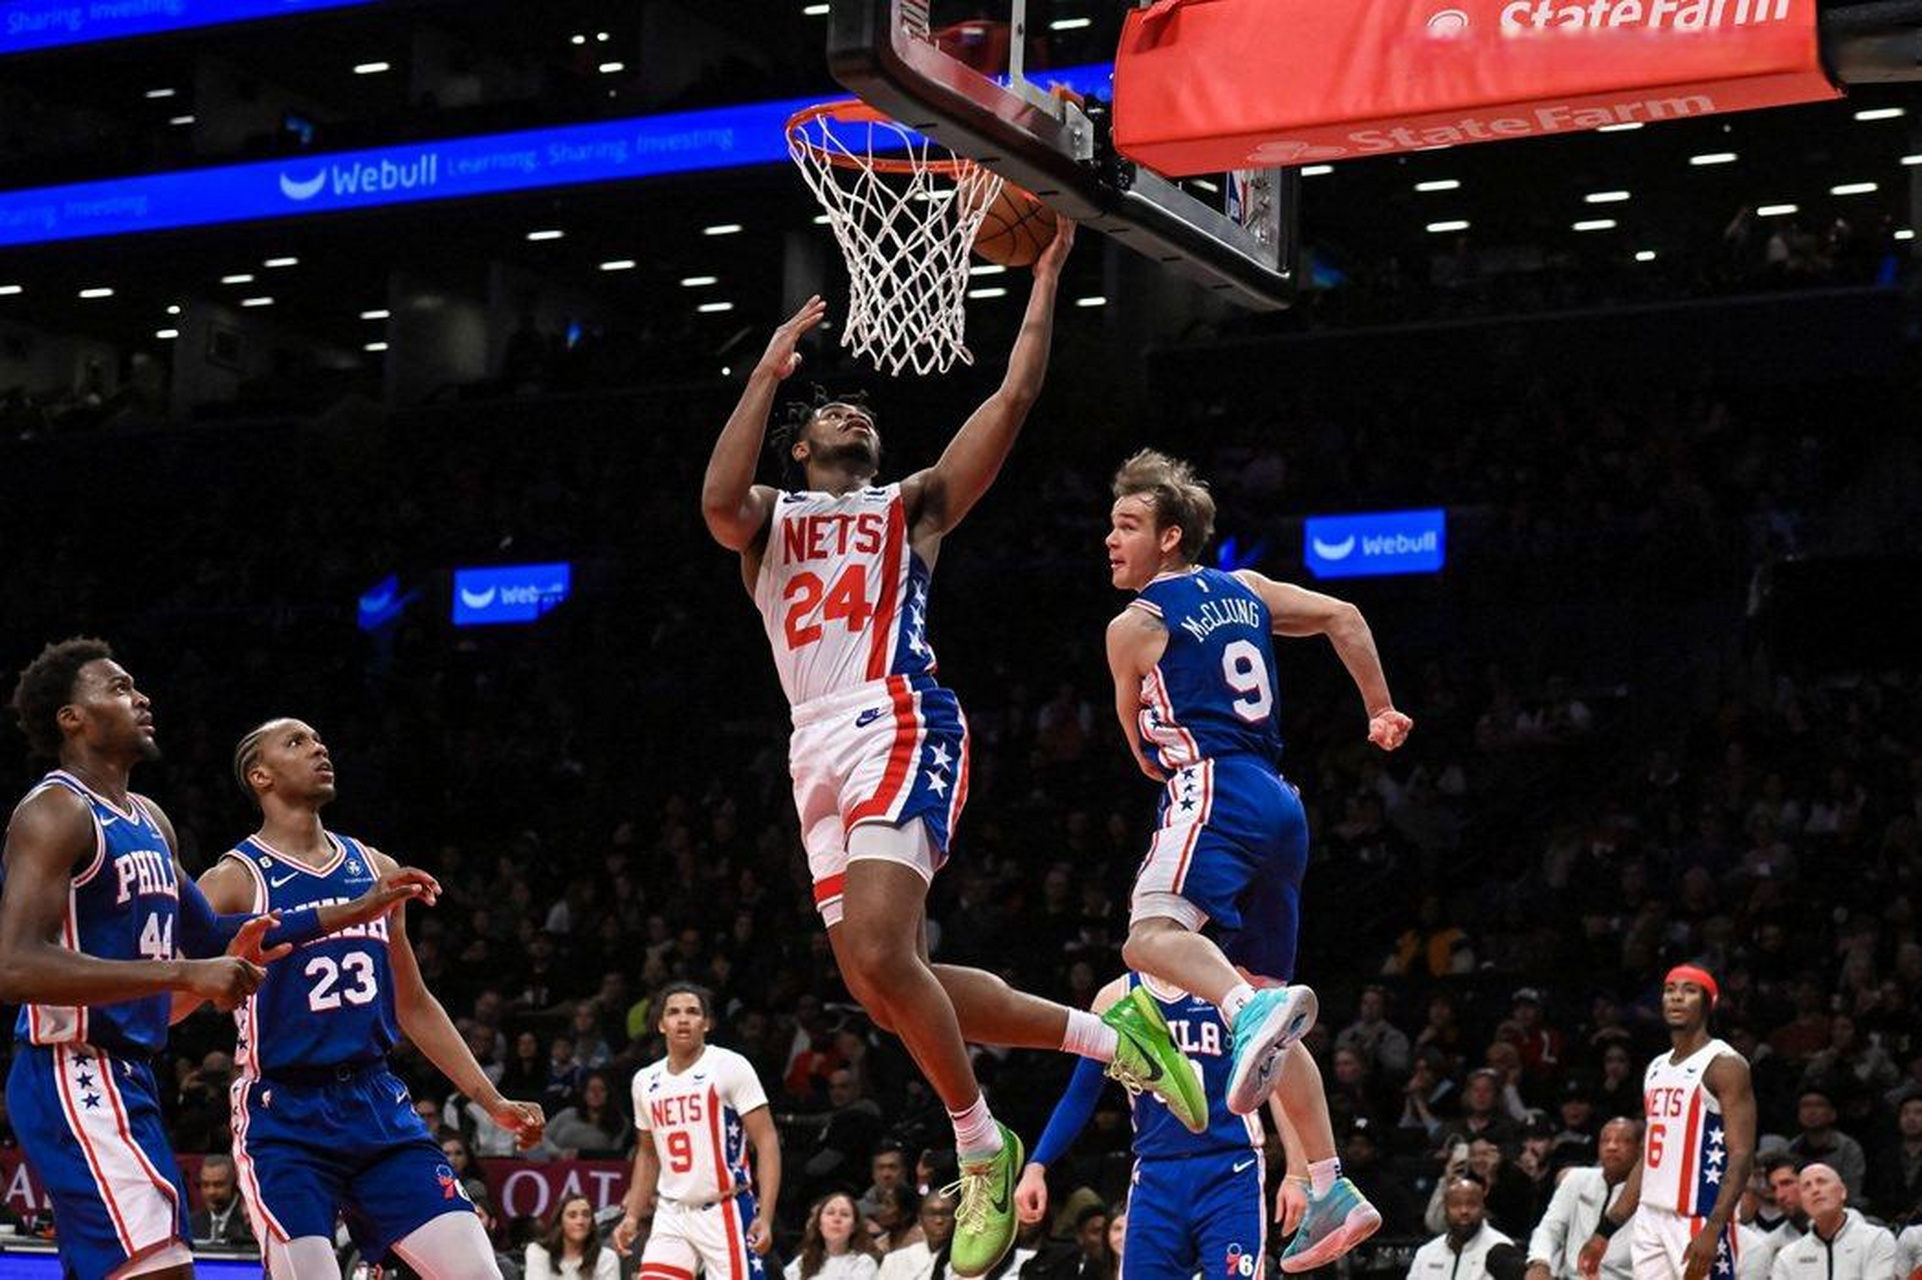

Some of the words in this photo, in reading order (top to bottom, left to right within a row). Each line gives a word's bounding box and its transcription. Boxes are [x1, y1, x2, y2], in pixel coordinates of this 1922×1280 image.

[331, 153, 438, 196] Webull
[783, 513, 882, 565] NETS
[1362, 531, 1437, 555] Webull
[783, 564, 873, 651] 24
[1181, 598, 1260, 643] McCLUNG
[1222, 639, 1273, 722] 9
[305, 951, 378, 1011] 23
[651, 1093, 702, 1128] NETS
[667, 1131, 692, 1174] 9
[1648, 1123, 1666, 1169] 6
